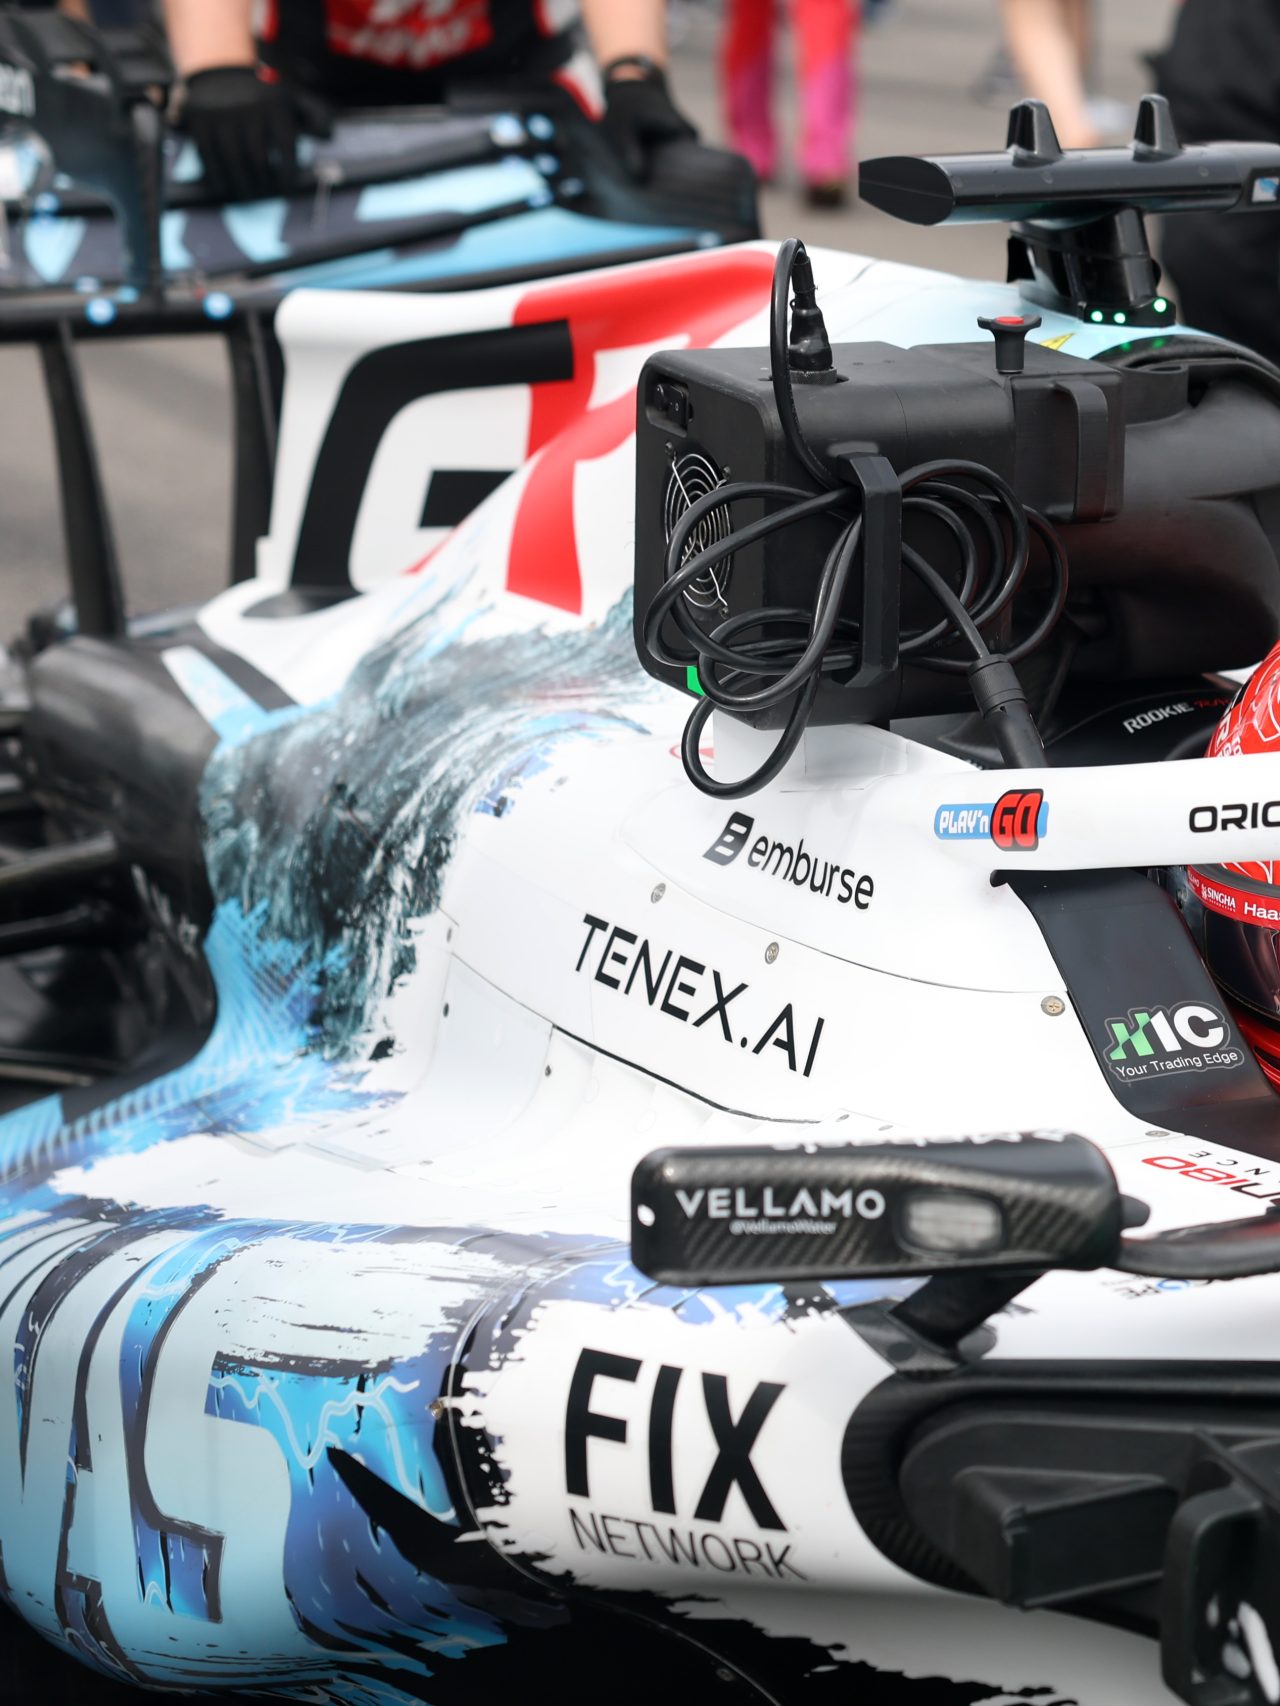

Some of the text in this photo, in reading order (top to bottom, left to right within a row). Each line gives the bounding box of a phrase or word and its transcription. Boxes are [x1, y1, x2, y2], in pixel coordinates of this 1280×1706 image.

[1122, 702, 1195, 735] ROOKIE
[992, 792, 1041, 848] GO
[747, 836, 875, 910] emburse
[1206, 887, 1237, 909] SINGHA
[575, 913, 825, 1078] TENEX.AI
[1116, 1051, 1238, 1078] Your Trading Edge
[674, 1187, 886, 1220] VELLAMO
[564, 1346, 789, 1533] FIX
[568, 1507, 810, 1582] NETWORK
